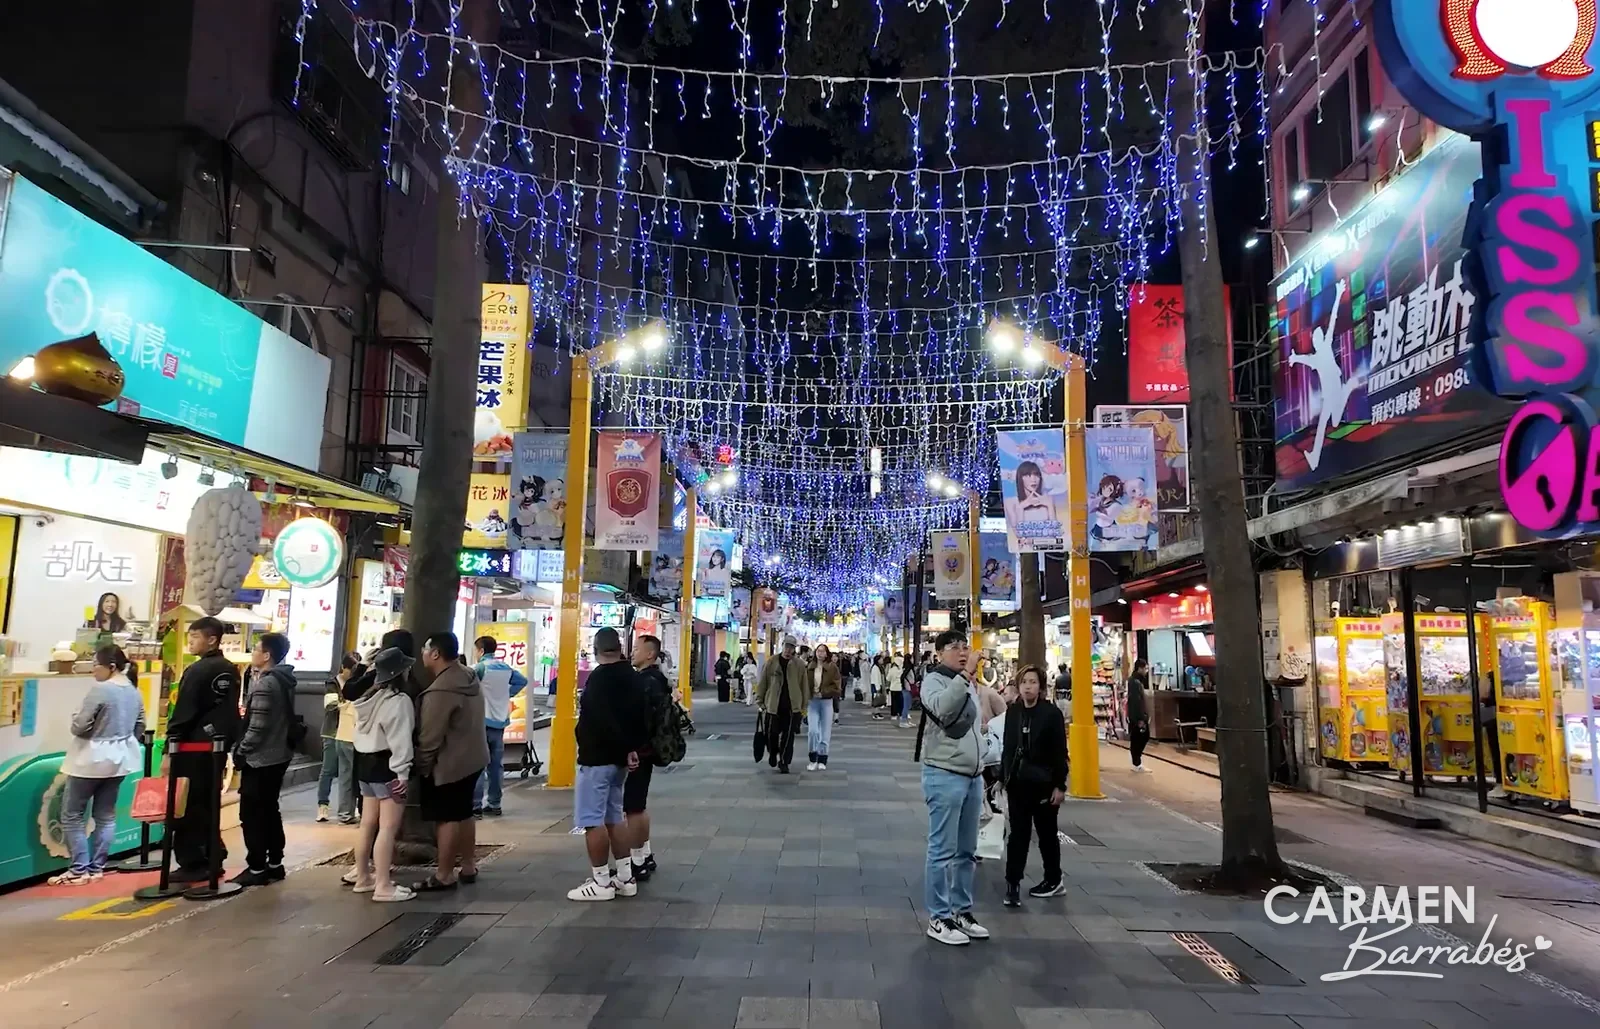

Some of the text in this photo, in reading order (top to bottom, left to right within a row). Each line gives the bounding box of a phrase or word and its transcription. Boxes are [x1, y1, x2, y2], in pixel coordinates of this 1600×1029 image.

[476, 341, 505, 408] 芒果冰
[42, 540, 133, 583] 苦瓜大王
